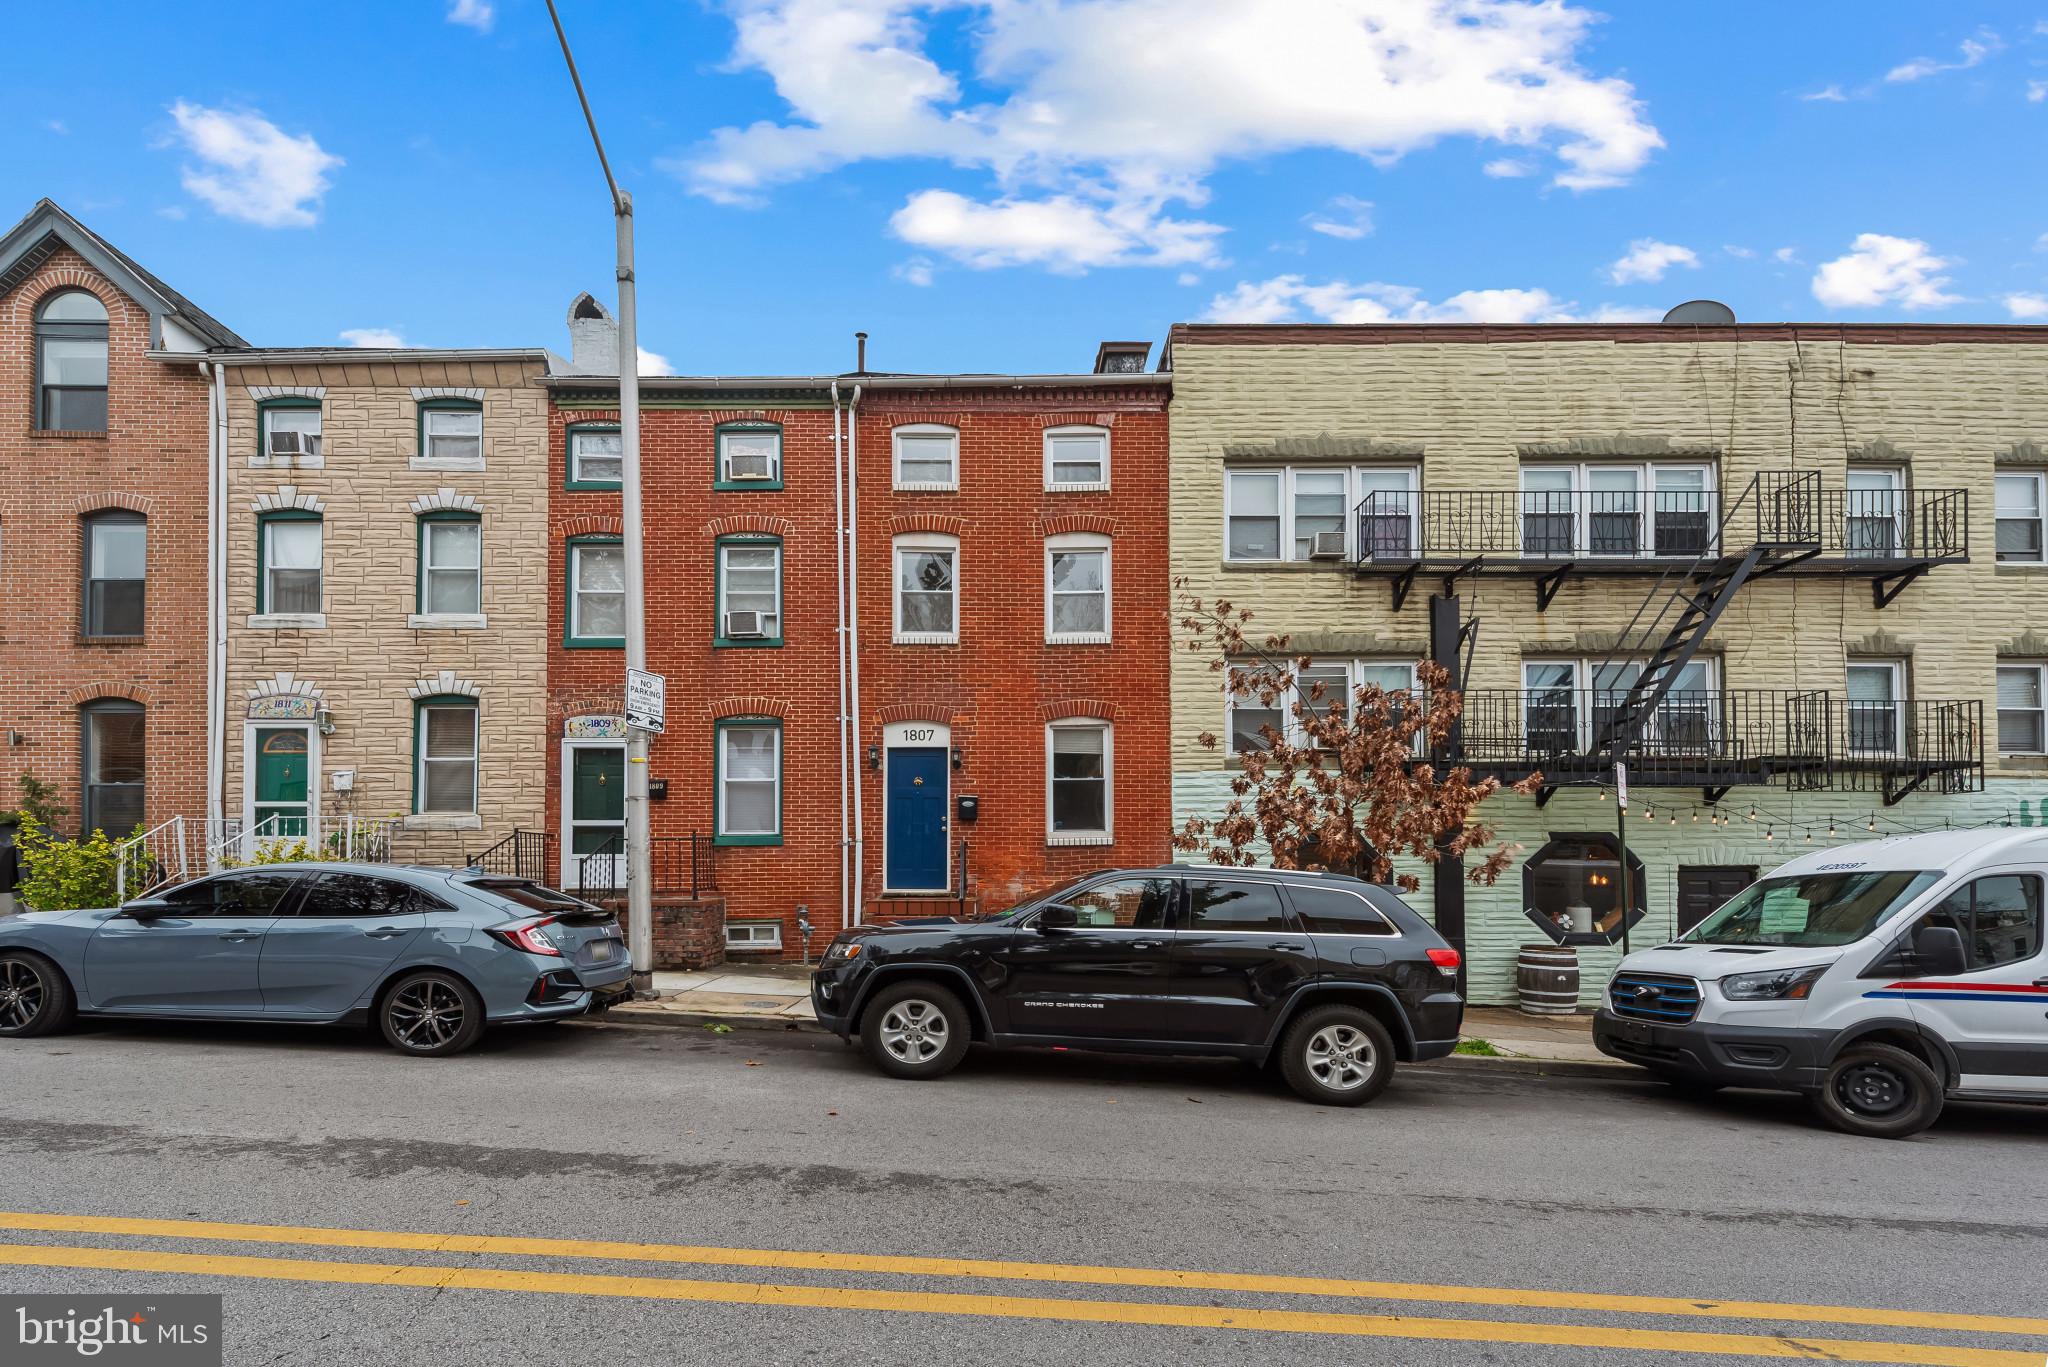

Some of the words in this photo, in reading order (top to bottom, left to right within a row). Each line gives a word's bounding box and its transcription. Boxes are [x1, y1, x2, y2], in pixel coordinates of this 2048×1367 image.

[641, 680, 652, 688] NO
[630, 686, 660, 699] PARKING
[274, 700, 291, 708] 1811
[590, 719, 610, 727] 1809
[903, 729, 934, 741] 1807
